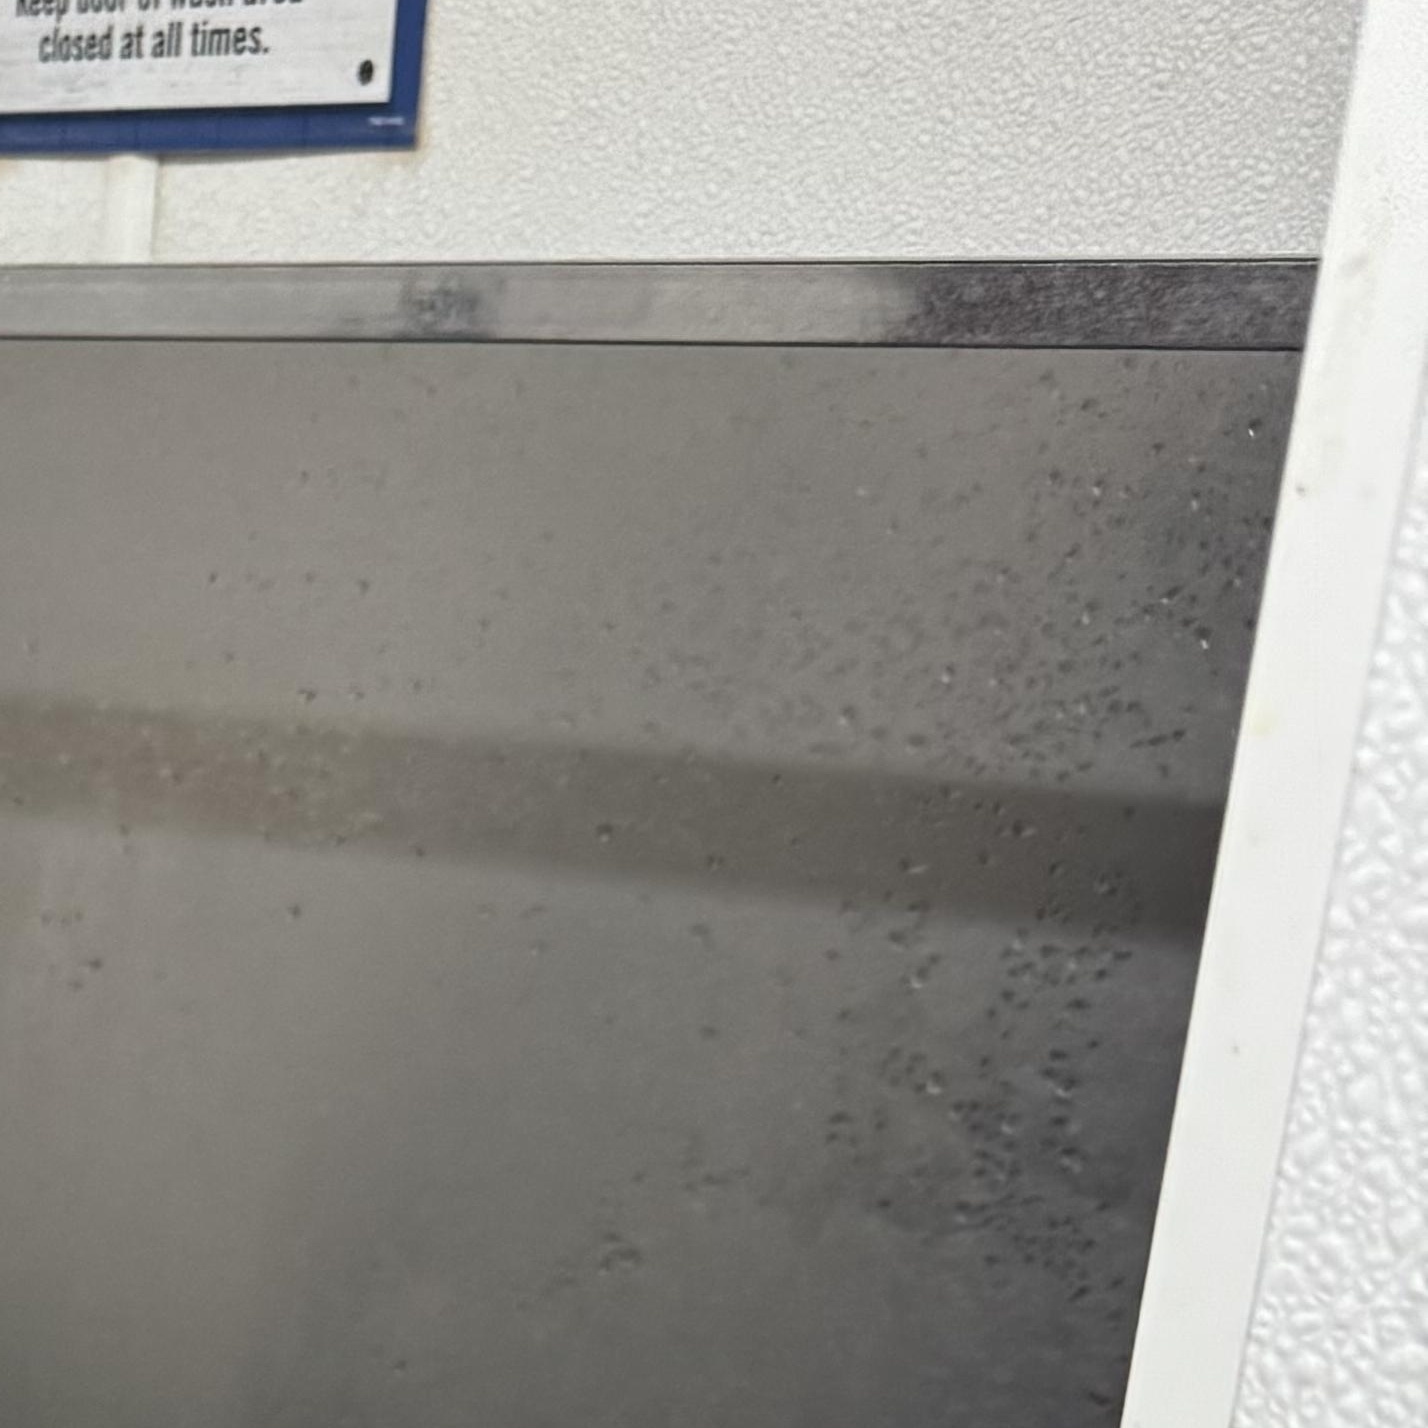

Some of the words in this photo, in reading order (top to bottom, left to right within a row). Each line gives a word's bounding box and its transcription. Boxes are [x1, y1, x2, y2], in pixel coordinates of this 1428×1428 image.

[38, 25, 114, 63] closed
[120, 24, 143, 60] at
[150, 21, 183, 59] all
[190, 19, 270, 57] times.
